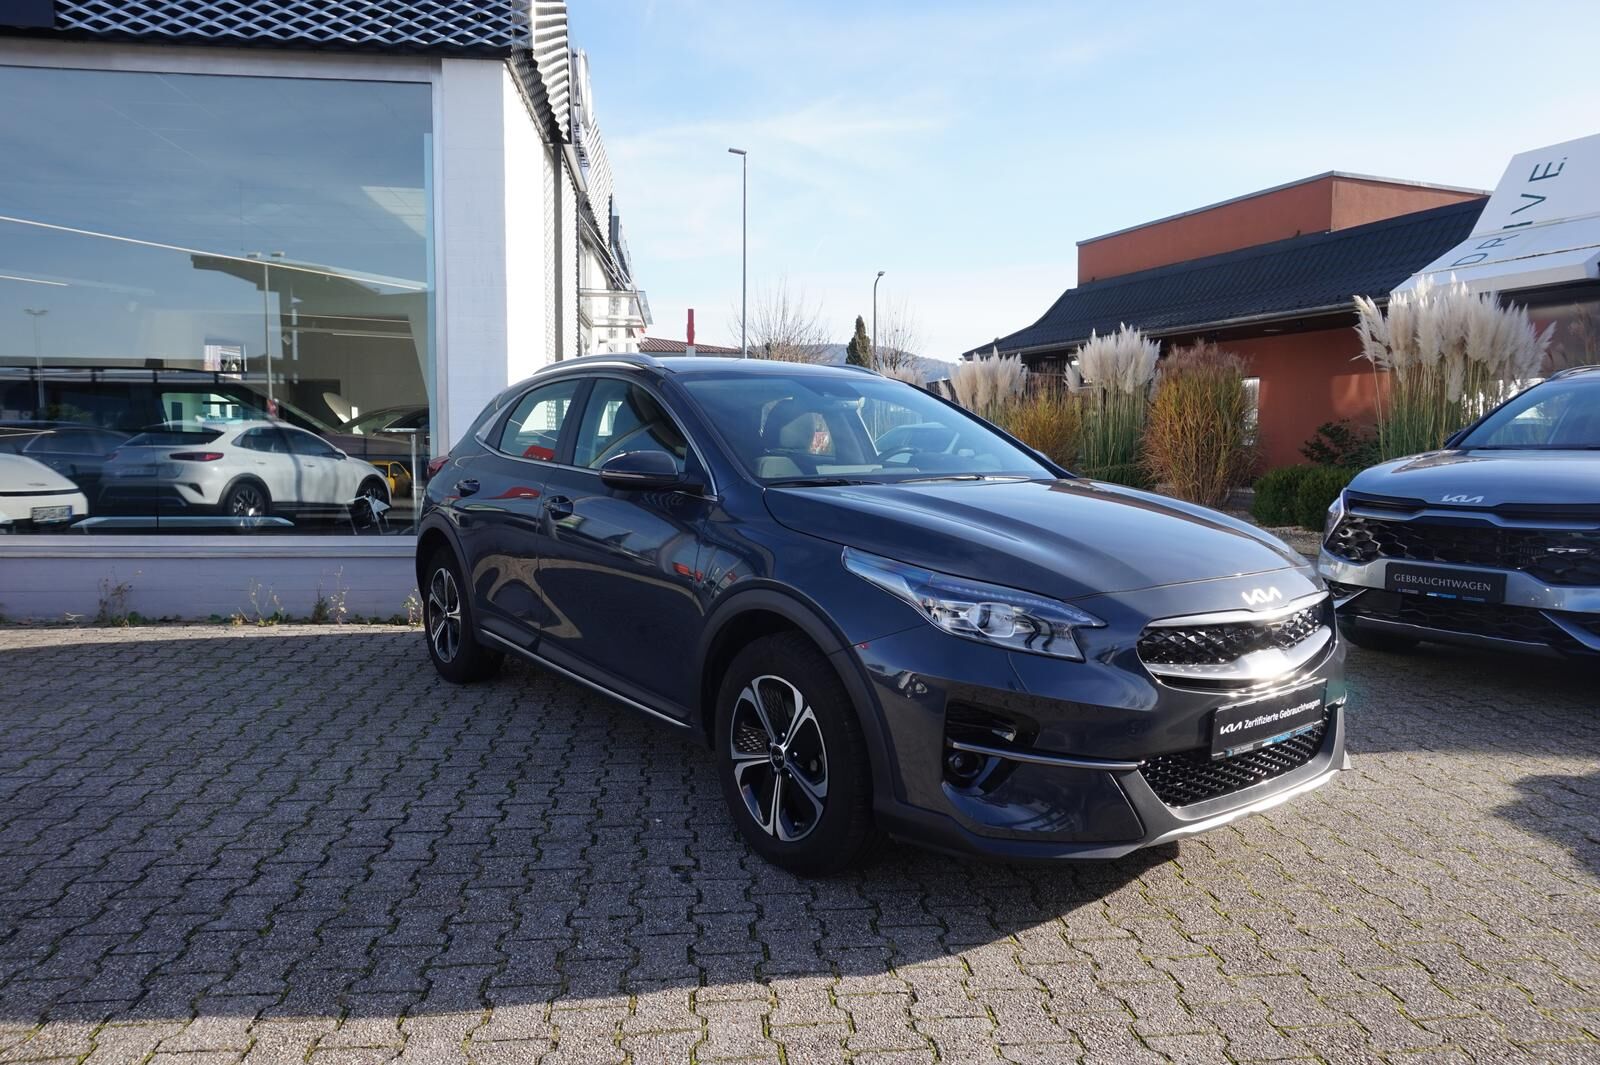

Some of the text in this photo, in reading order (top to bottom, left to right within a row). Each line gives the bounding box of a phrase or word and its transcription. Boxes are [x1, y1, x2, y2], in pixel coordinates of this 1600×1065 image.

[1393, 573, 1491, 591] GEBRAUCHTWAGEN
[1220, 698, 1321, 735] KIA Zertifizierte Gebrauchtwagen
